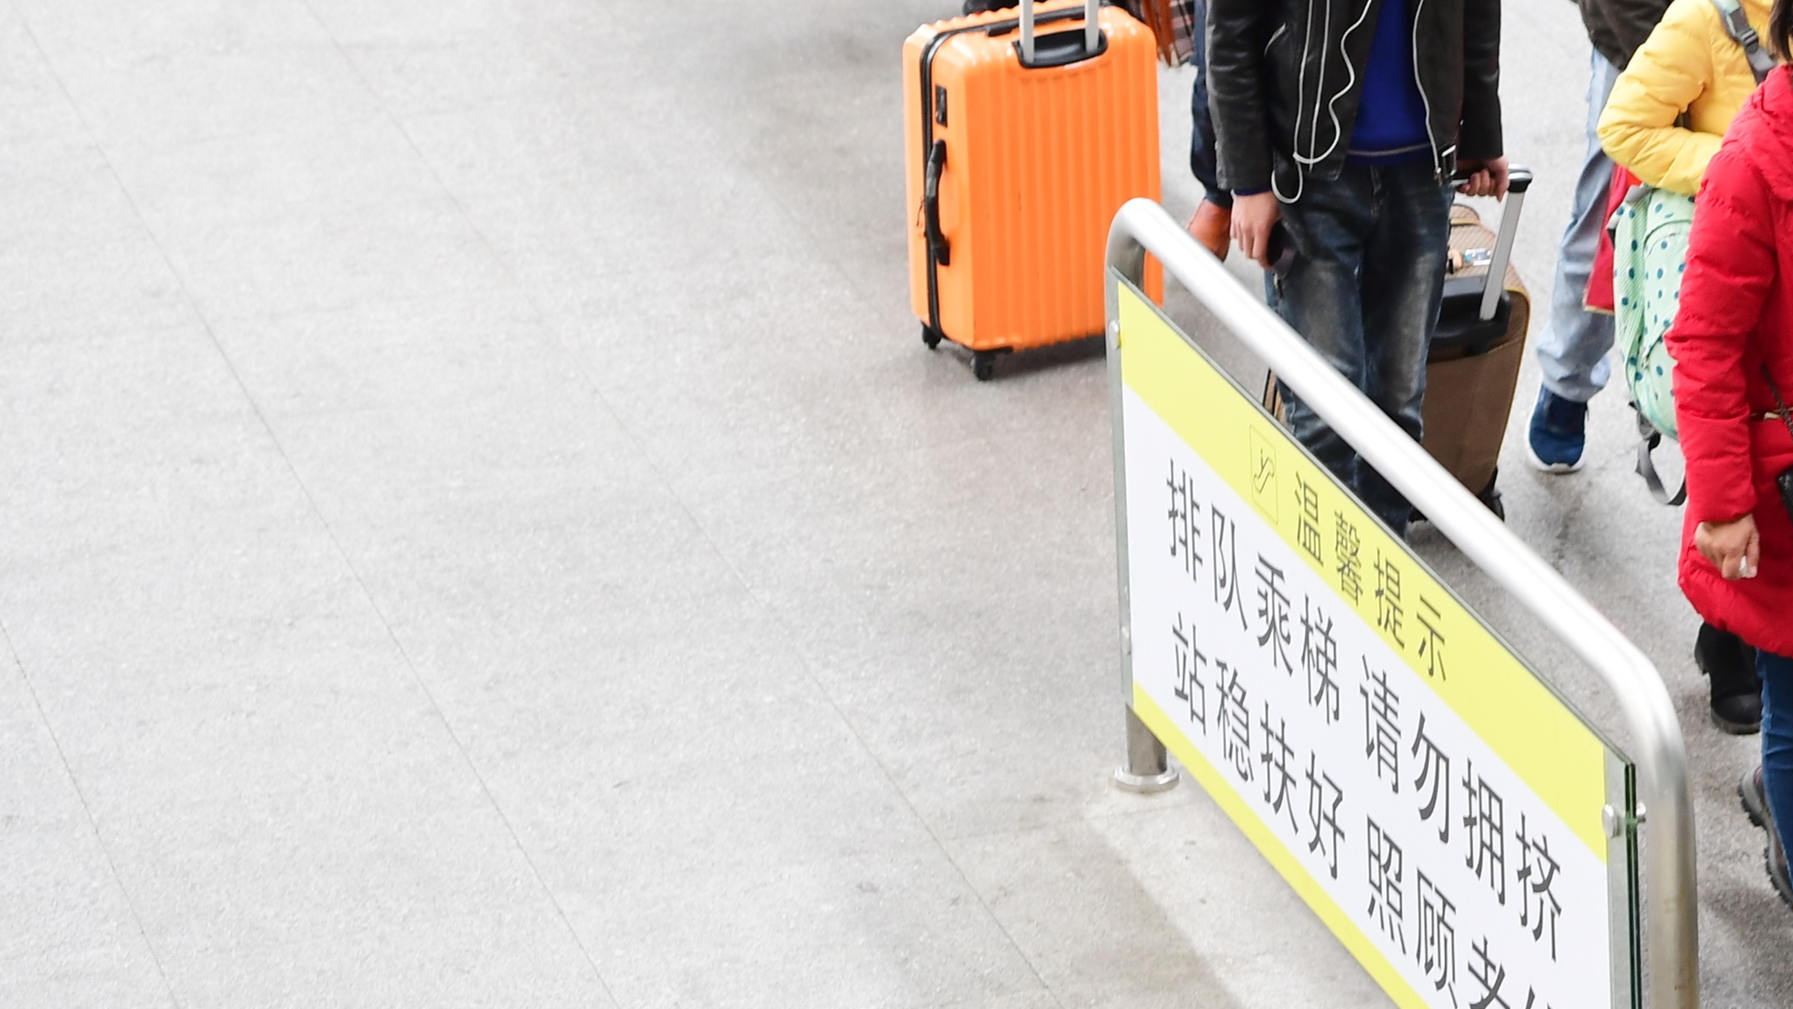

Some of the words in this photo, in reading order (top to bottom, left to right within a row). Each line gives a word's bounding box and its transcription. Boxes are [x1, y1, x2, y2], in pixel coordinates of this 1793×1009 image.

[1166, 459, 1340, 727] 排队乘梯
[1359, 654, 1563, 963] 请勿拥挤
[1294, 471, 1447, 682] 温馨提示
[1171, 612, 1346, 880] 站稳扶好
[1366, 815, 1553, 1009] 照顾老
